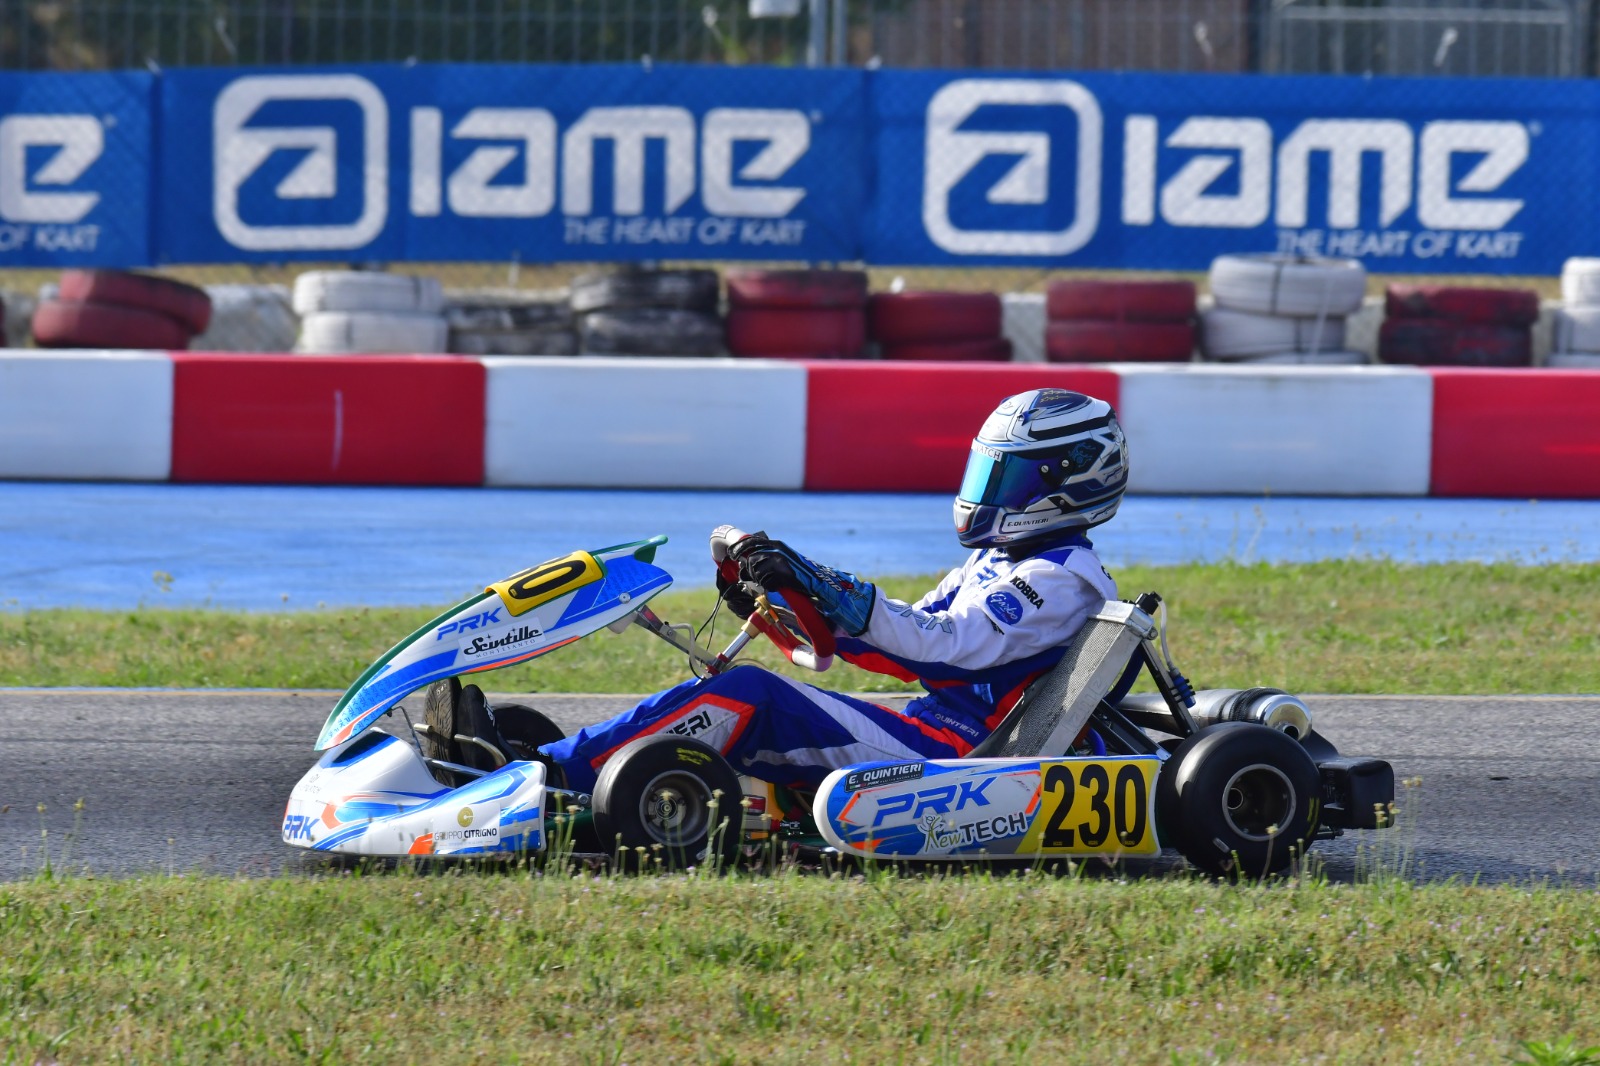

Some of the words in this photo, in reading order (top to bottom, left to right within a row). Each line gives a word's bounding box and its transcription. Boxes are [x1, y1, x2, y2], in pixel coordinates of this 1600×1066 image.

[34, 223, 101, 252] KART
[563, 216, 610, 245] THE
[612, 216, 696, 245] HEART
[697, 217, 738, 245] OF
[739, 218, 807, 246] KART
[1276, 229, 1325, 257] THE
[1326, 229, 1412, 257] HEART
[1411, 230, 1453, 258] OF
[1455, 231, 1525, 258] KART
[1009, 575, 1045, 610] KOBRA
[436, 606, 502, 641] PRK
[475, 638, 537, 659] MONTESANTO
[934, 713, 980, 738] QUINTIERI
[863, 763, 922, 782] QUINTIERI
[872, 776, 998, 827] PRK
[1042, 764, 1147, 848] 230
[284, 814, 320, 841] PRK
[463, 827, 498, 839] CITRIGNO
